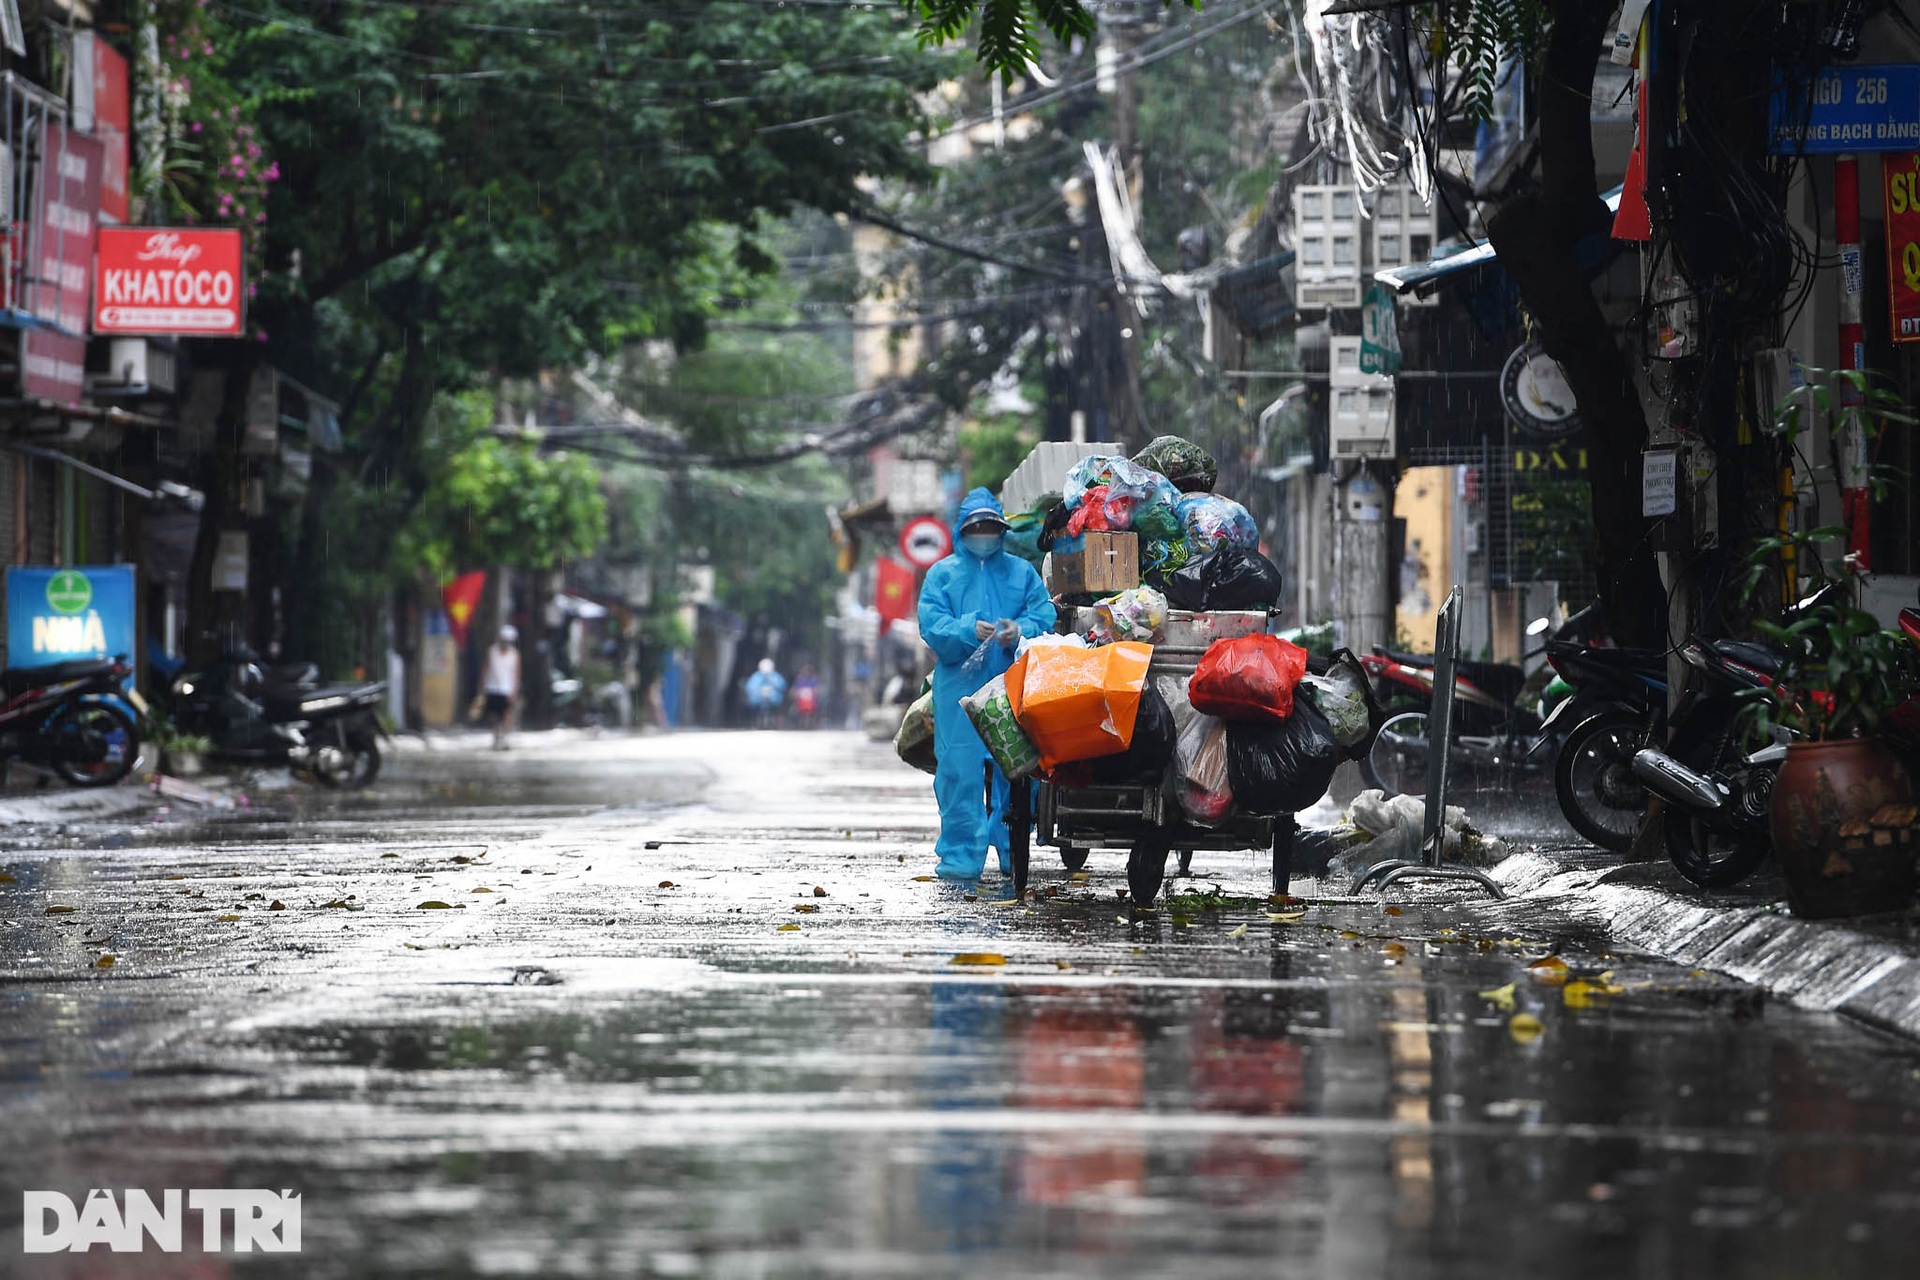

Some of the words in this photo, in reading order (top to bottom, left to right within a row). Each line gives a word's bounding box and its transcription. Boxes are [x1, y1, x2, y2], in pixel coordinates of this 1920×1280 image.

[1855, 77, 1888, 105] 256
[1831, 123, 1873, 144] BẠCH
[1877, 114, 1920, 139] ĐẰNG
[104, 268, 234, 305] KHATOCO
